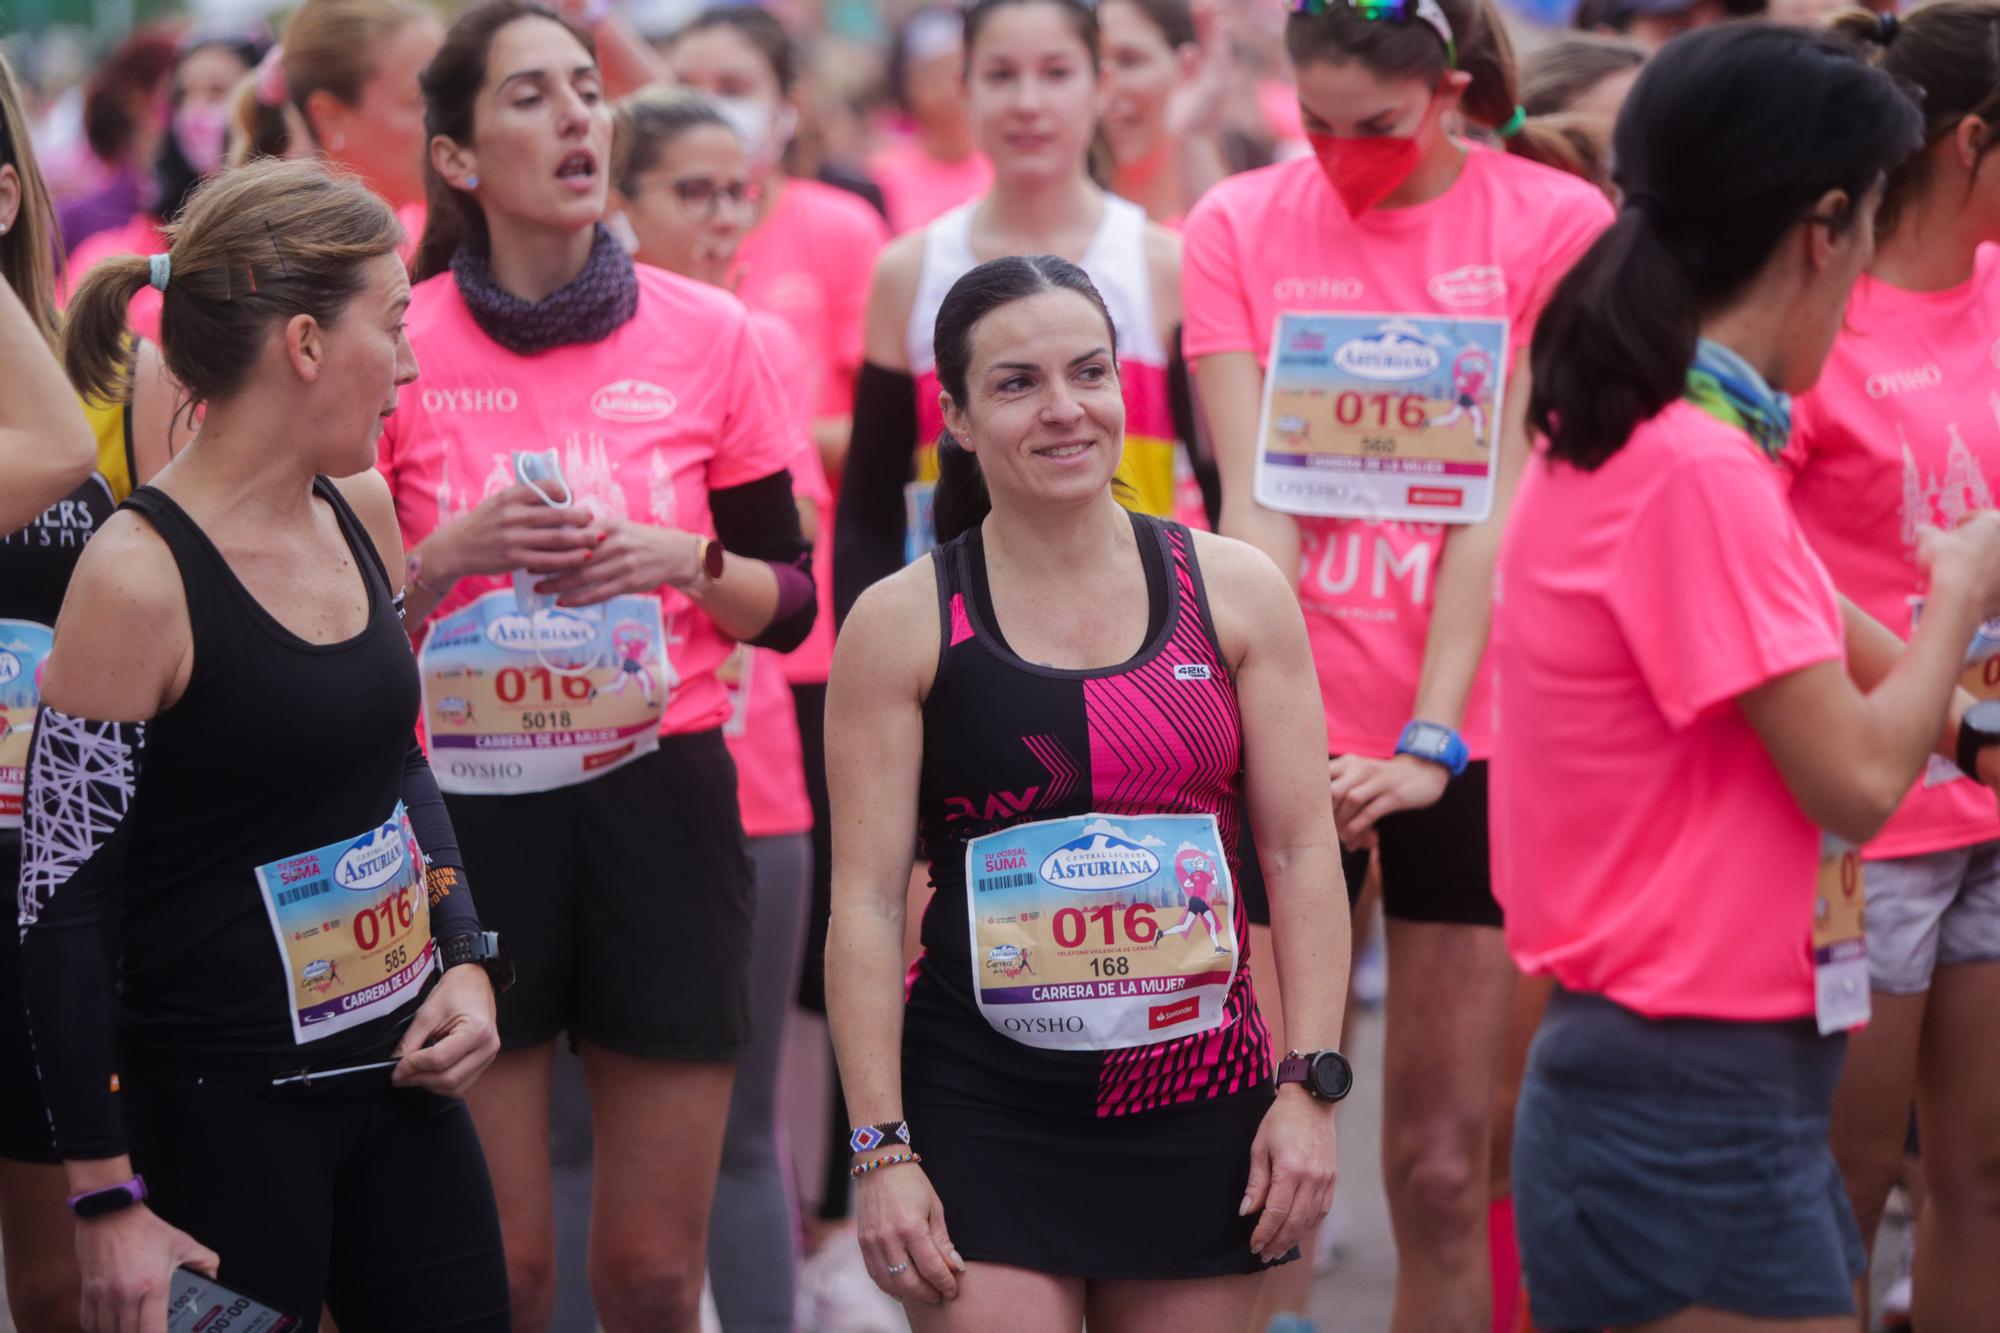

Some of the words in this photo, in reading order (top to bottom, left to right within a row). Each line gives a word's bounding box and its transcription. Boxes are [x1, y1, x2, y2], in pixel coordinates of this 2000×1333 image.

[421, 387, 518, 413] OYSHO
[1335, 391, 1426, 428] 016
[34, 501, 93, 529] ERS
[1178, 666, 1206, 675] 42K
[495, 664, 592, 703] 016
[522, 711, 572, 730] 5018
[451, 762, 522, 779] OYSHO
[996, 848, 1027, 858] DORSAL
[1066, 852, 1105, 862] CENTRAL
[985, 856, 1027, 873] SUMA
[1049, 859, 1153, 880] ASTURIANA
[428, 876, 457, 893] STORA
[353, 887, 412, 951] 016
[1052, 903, 1159, 948] 016
[385, 944, 407, 973] 585
[1090, 956, 1129, 977] 168
[343, 984, 392, 1010] CARRERA
[1032, 984, 1095, 1001] CARRERA
[1099, 982, 1116, 996] DE
[1119, 981, 1137, 995] LA
[1141, 978, 1186, 993] MUJER
[1165, 1006, 1192, 1019] Santander
[1004, 1016, 1084, 1033] OYSHO
